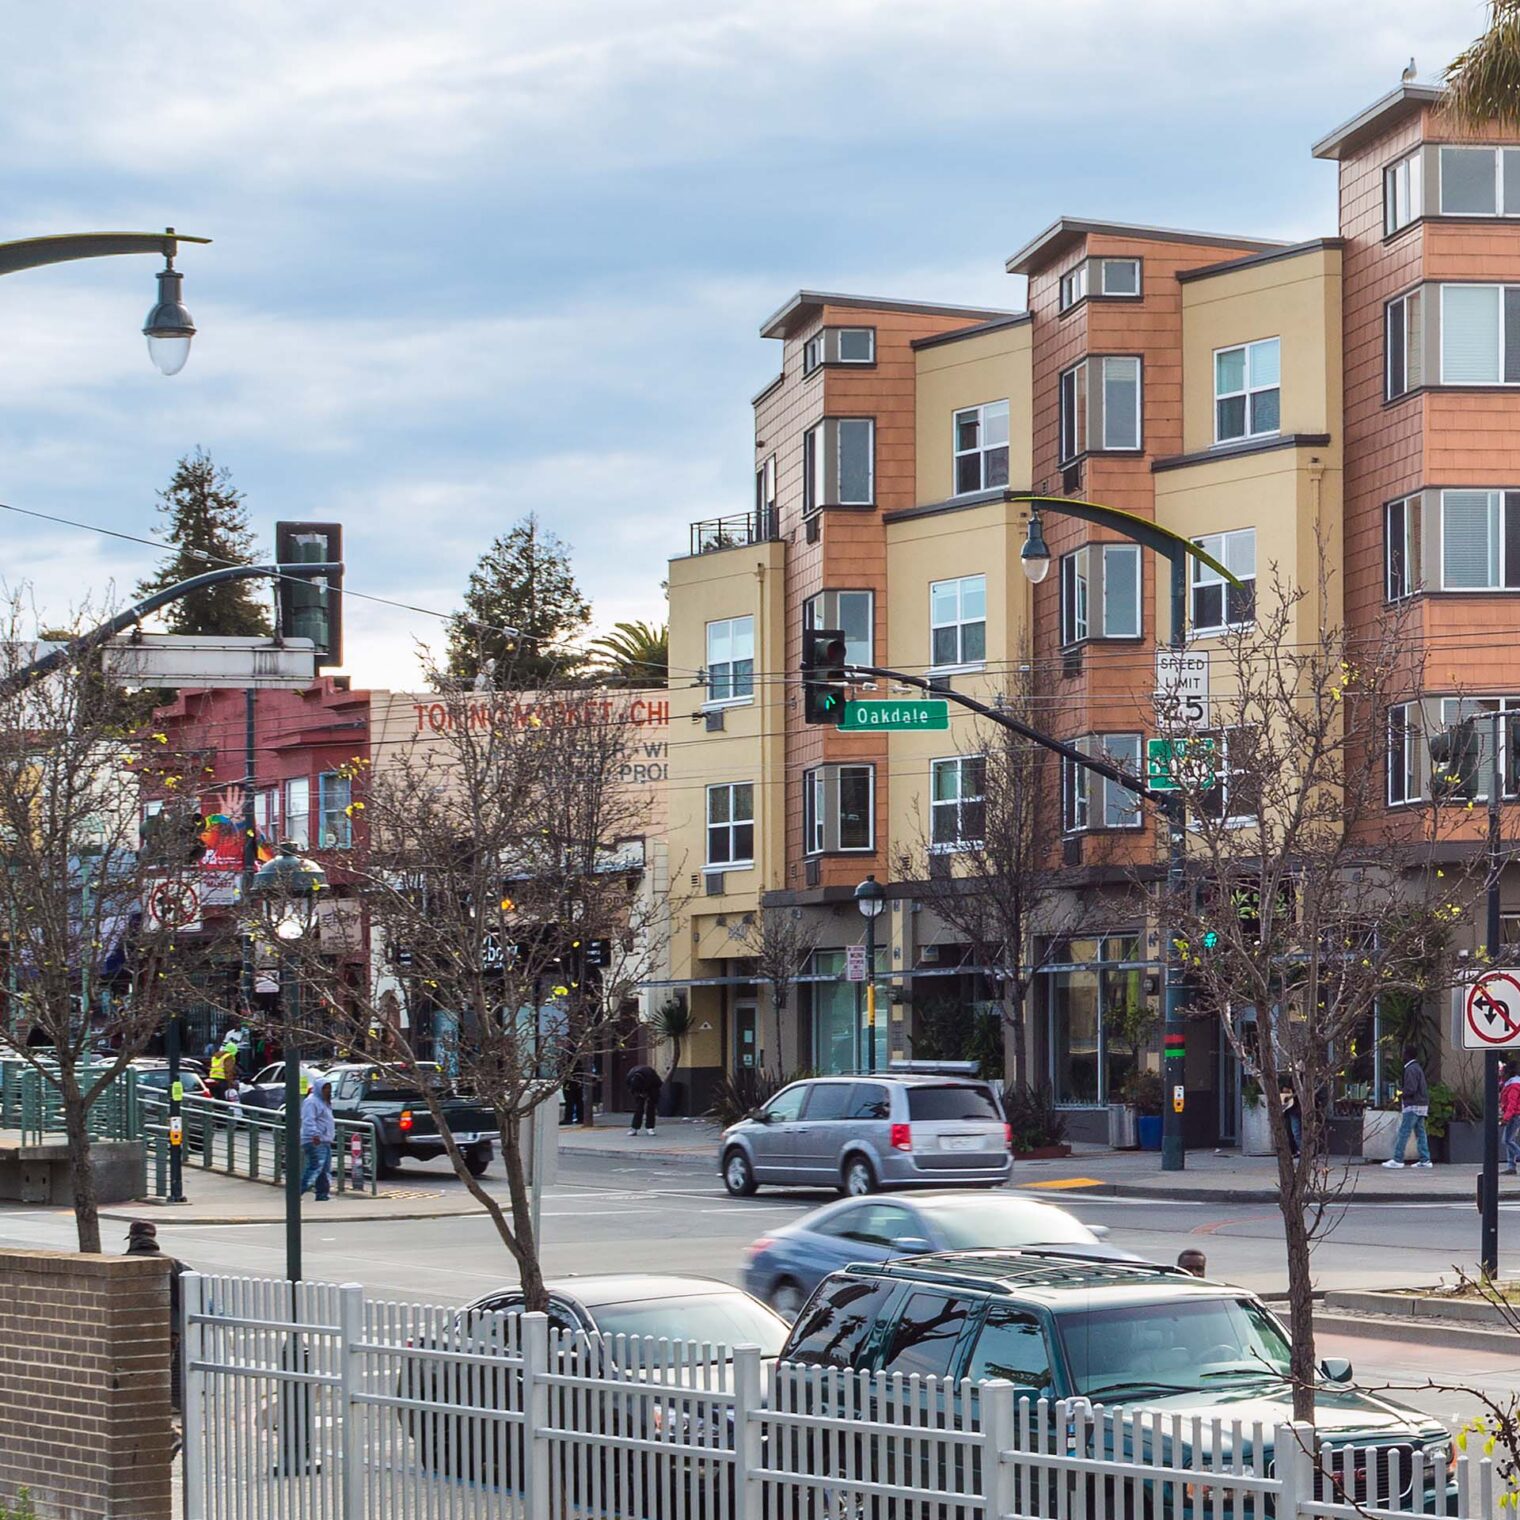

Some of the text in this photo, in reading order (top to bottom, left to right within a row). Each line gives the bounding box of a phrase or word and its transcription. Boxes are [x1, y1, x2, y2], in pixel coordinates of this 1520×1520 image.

[1160, 658, 1205, 671] SPEED
[1165, 677, 1201, 689] LIMIT
[857, 707, 928, 724] Oakdale
